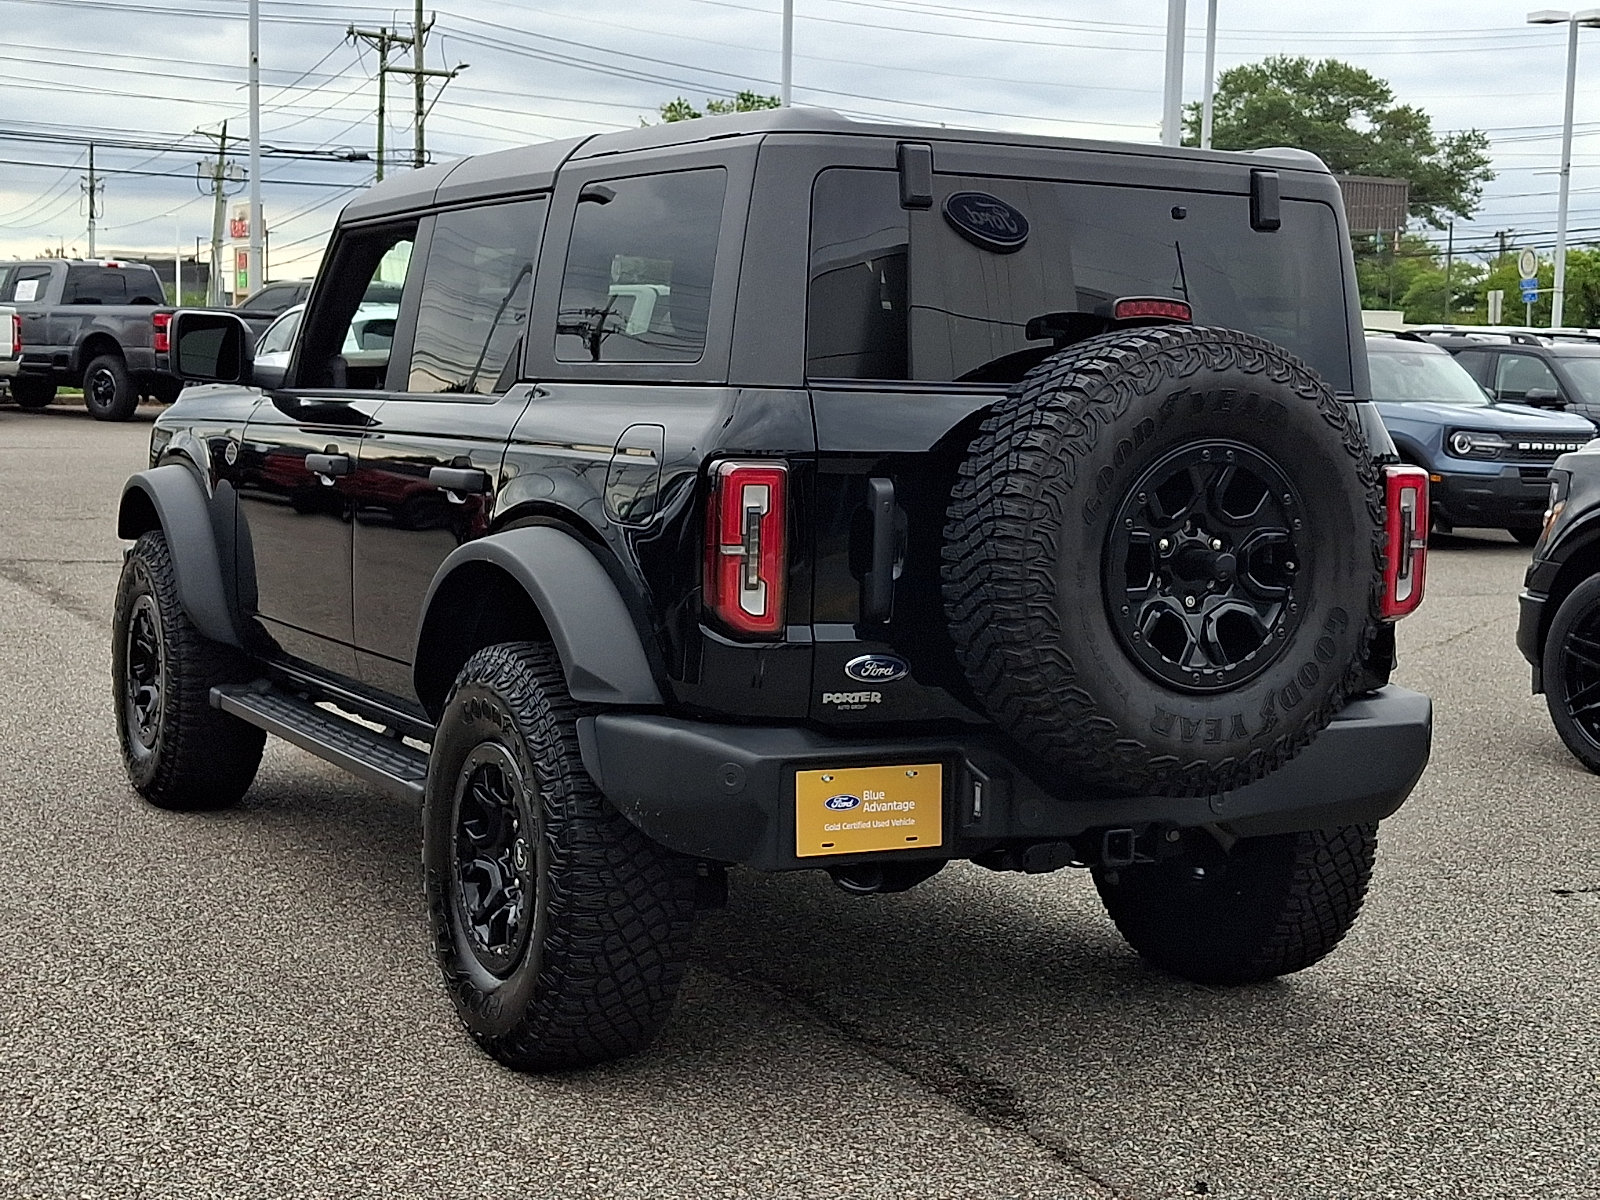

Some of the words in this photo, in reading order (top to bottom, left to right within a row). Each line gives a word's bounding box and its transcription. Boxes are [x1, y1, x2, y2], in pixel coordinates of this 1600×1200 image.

[1518, 442, 1587, 451] BRONCO
[860, 660, 895, 677] Ford
[822, 691, 882, 704] PORTER
[863, 790, 885, 801] Blue
[830, 797, 854, 809] Ford
[863, 801, 916, 813] Advantage
[824, 823, 841, 832] Gold
[842, 820, 871, 830] Certified
[872, 819, 890, 828] Used
[891, 817, 916, 827] Vehicle
